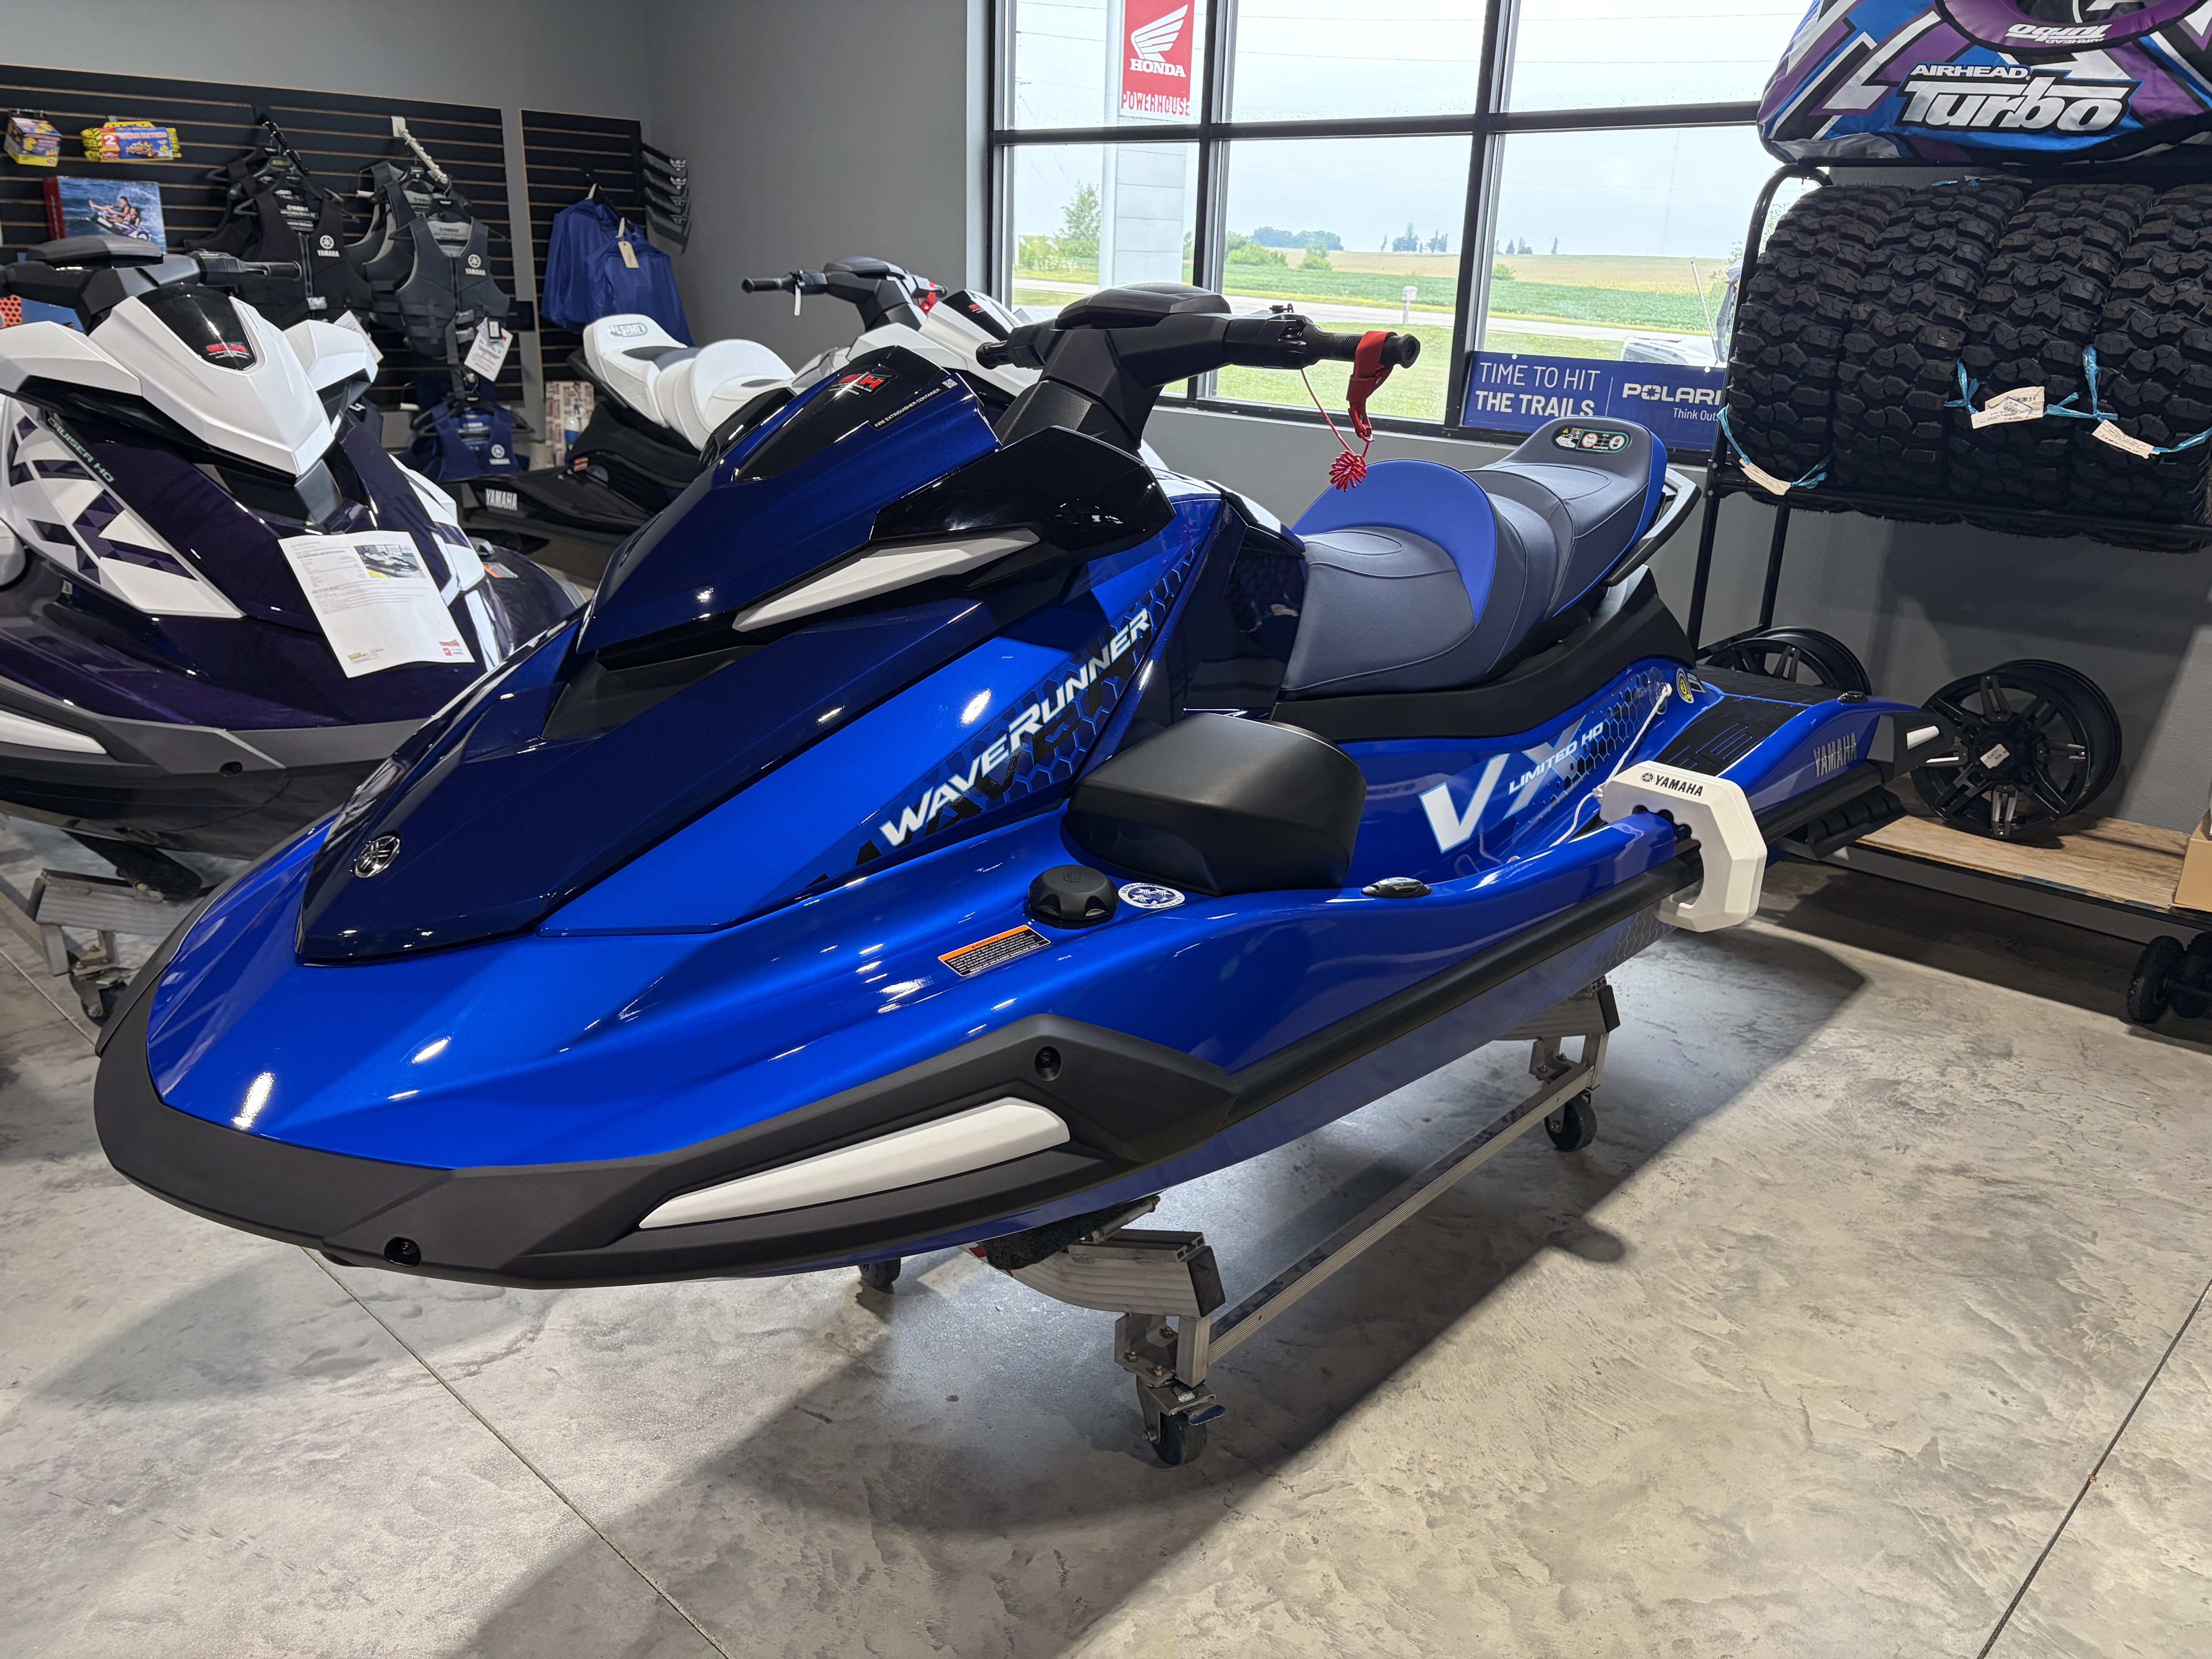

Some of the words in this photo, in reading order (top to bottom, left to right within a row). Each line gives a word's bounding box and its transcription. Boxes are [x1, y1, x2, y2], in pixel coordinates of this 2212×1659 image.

[2005, 24, 2112, 41] Turbo
[1130, 58, 1187, 77] HONDA
[1910, 65, 2029, 79] AIRHEAD
[1123, 91, 1190, 116] POWERHOUSE
[1902, 77, 2130, 131] Turbo
[103, 135, 116, 145] 2
[1480, 362, 1528, 386] TIME
[1534, 366, 1558, 388] TO
[1563, 368, 1601, 391] HIT
[1475, 390, 1515, 413] THE
[1519, 394, 1595, 417] TRAILS
[1622, 383, 1722, 405] POLARI
[874, 419, 886, 428] FIRE
[884, 401, 917, 422] EXTINGUISHER
[916, 388, 941, 403] CONTAINER
[1673, 408, 1697, 420] Think
[47, 417, 94, 463] CRUISER
[93, 463, 115, 483] HO
[485, 488, 518, 511] YAMAHA
[879, 608, 1152, 847] WAVERUNNER
[1508, 740, 1578, 795] LIMITED
[1581, 722, 1603, 747] HO
[1813, 732, 1857, 778] YAMAHA
[1655, 775, 1703, 797] YAMAHA
[975, 936, 1000, 947] WARNING
